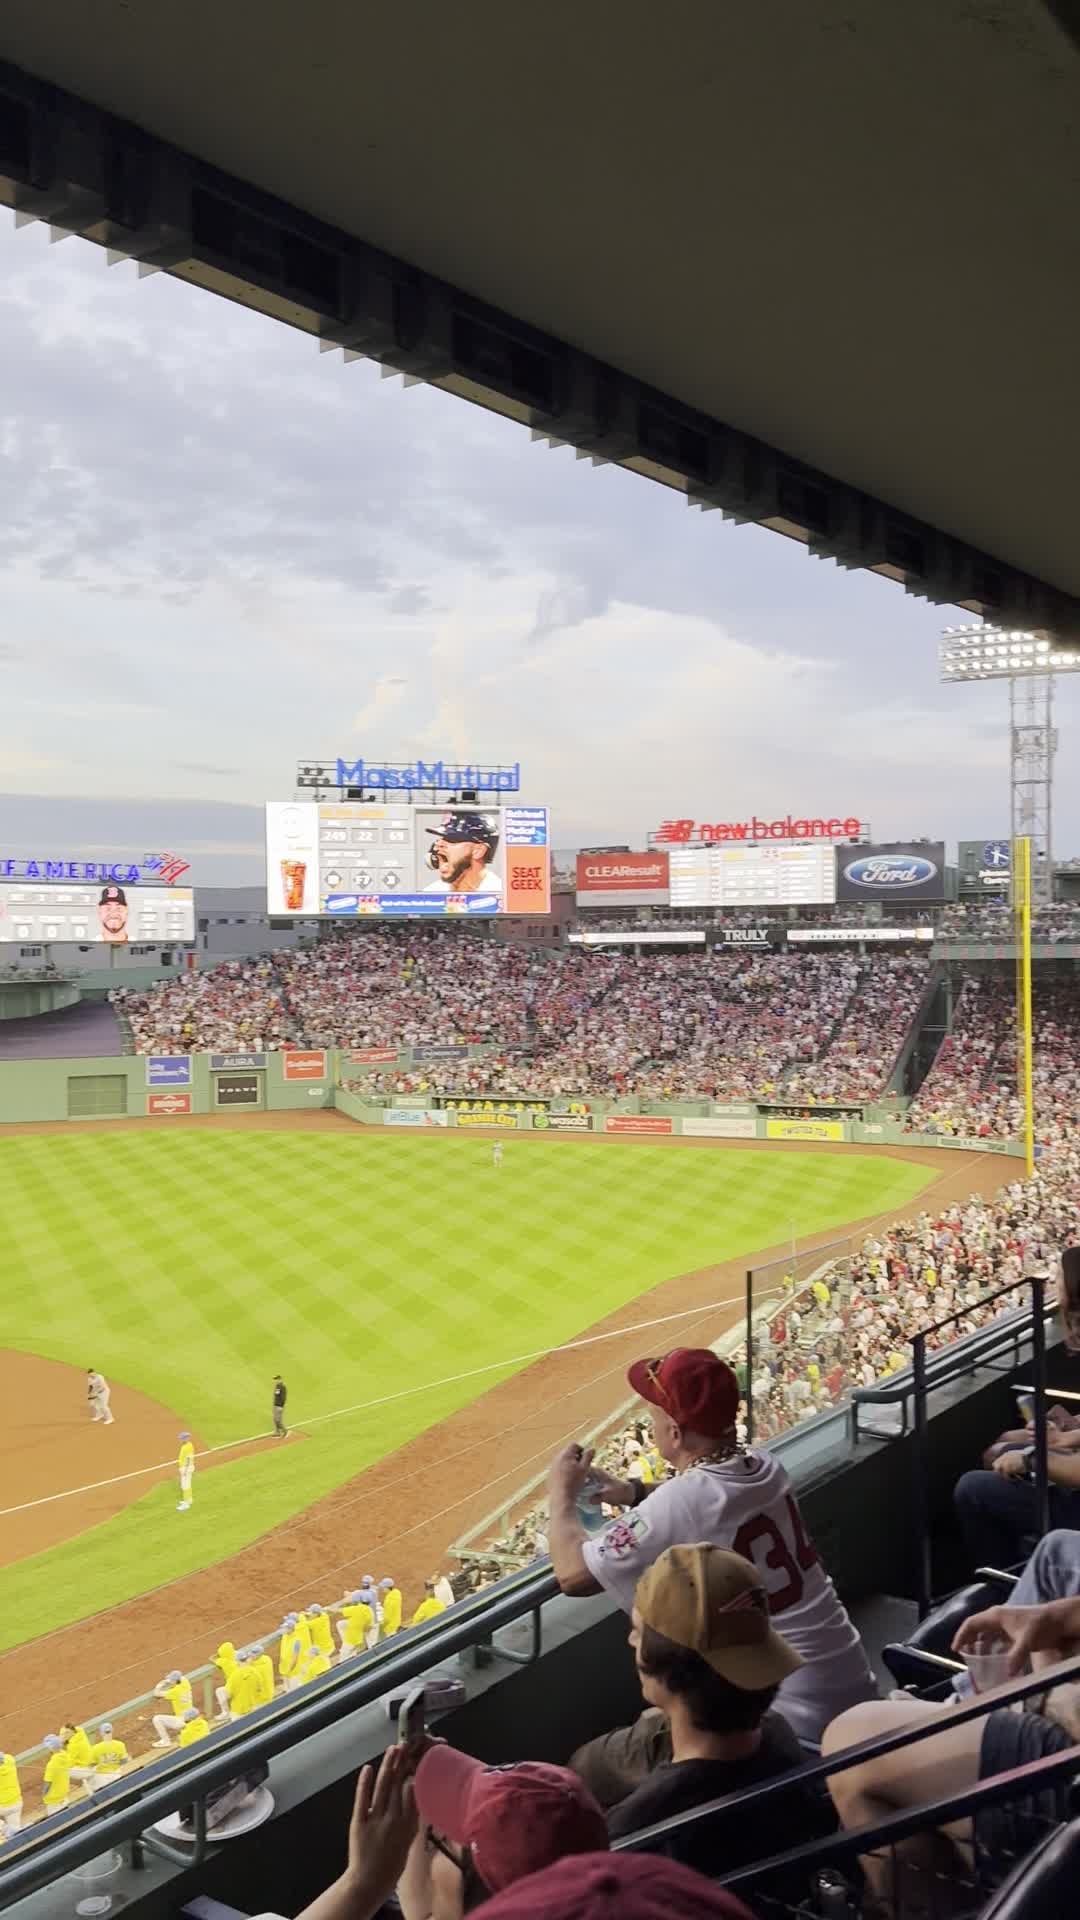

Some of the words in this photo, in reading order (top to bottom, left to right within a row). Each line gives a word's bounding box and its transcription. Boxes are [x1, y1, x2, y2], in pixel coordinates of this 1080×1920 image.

[336, 758, 519, 791] MassMutual
[697, 823, 747, 841] new
[751, 815, 860, 840] balance
[0, 859, 16, 878] F
[25, 858, 141, 882] AMERICA
[512, 867, 542, 878] SEAT
[861, 861, 918, 882] Ford
[511, 879, 543, 891] GEEK
[722, 930, 769, 940] TRULY
